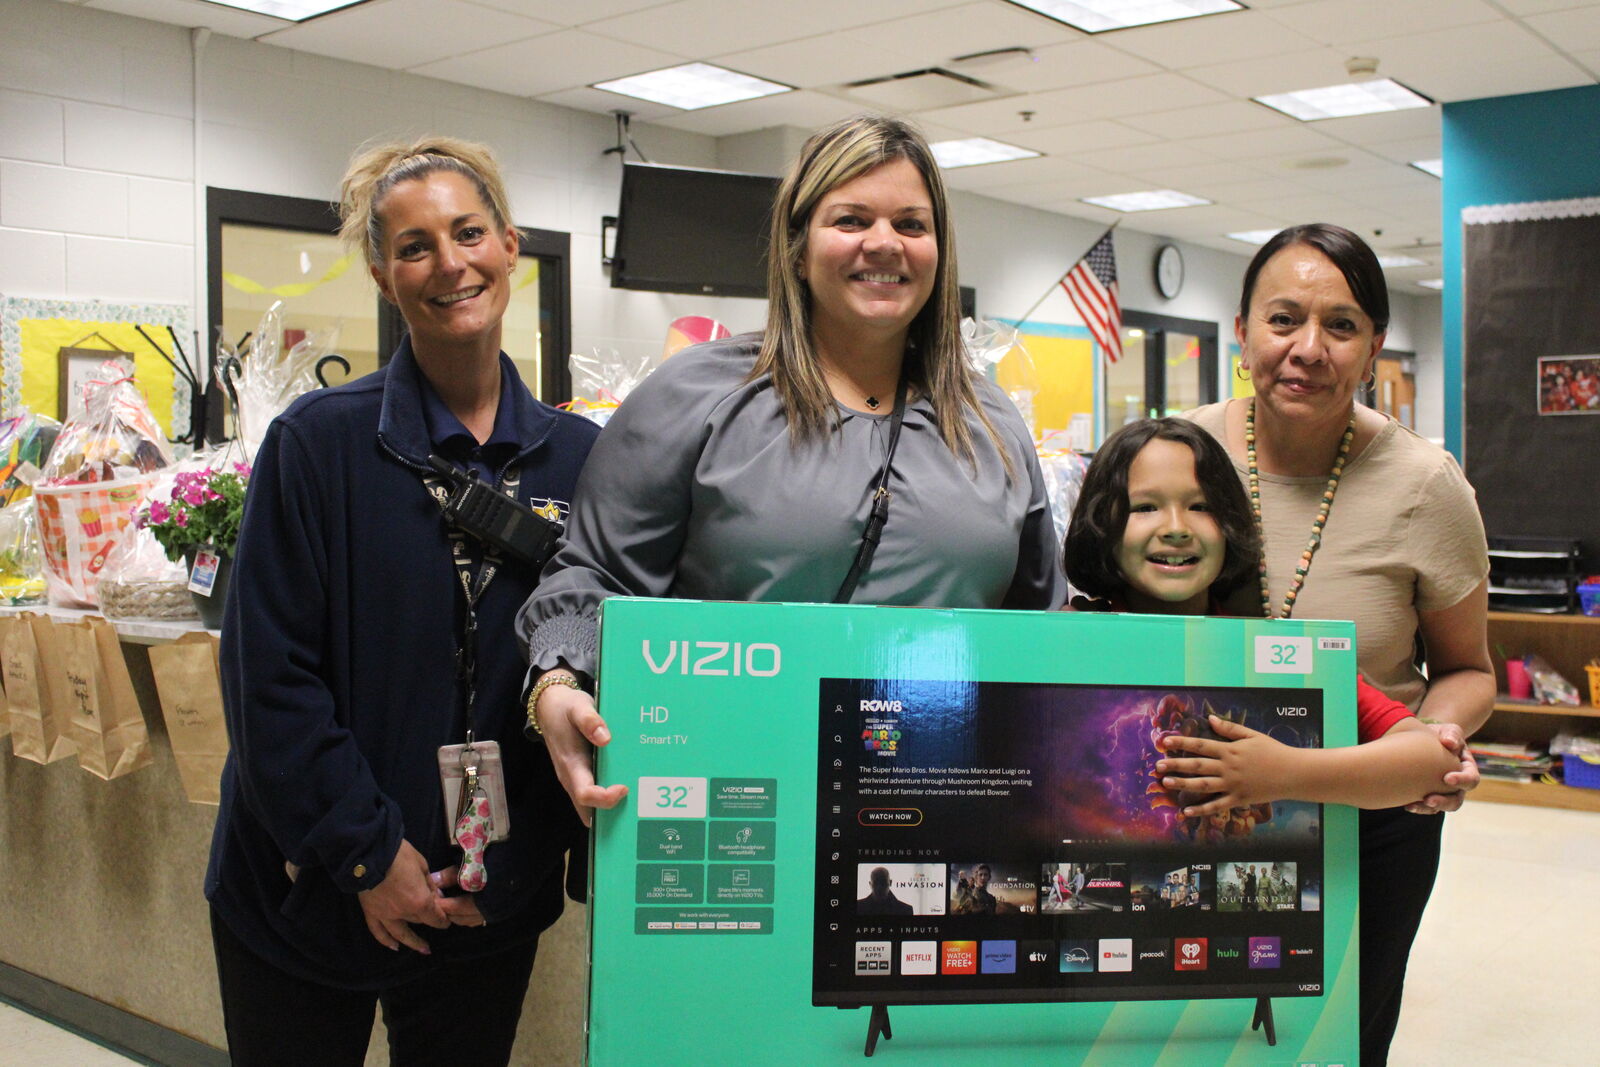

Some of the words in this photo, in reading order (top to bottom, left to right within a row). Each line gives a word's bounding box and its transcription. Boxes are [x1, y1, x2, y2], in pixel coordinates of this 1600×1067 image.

[642, 639, 781, 677] VIZIO
[860, 700, 902, 712] ROW8
[640, 706, 669, 723] HD
[1276, 707, 1308, 717] VIZIO
[640, 734, 671, 745] Smart
[674, 735, 688, 745] TV
[861, 730, 902, 741] MARIO
[873, 767, 891, 775] Super
[1002, 768, 1017, 776] Luigi
[922, 778, 947, 786] through
[982, 778, 1011, 787] Kingdom,
[1011, 779, 1033, 787] uniting
[1220, 896, 1294, 904] OUTLANDER
[1132, 903, 1146, 912] ion
[906, 954, 932, 962] NETFLIX
[1064, 952, 1090, 964] Disney+
[1140, 951, 1165, 960] peacock
[1217, 949, 1239, 958] hulu
[1252, 951, 1278, 964] gram
[946, 960, 972, 968] FREE+
